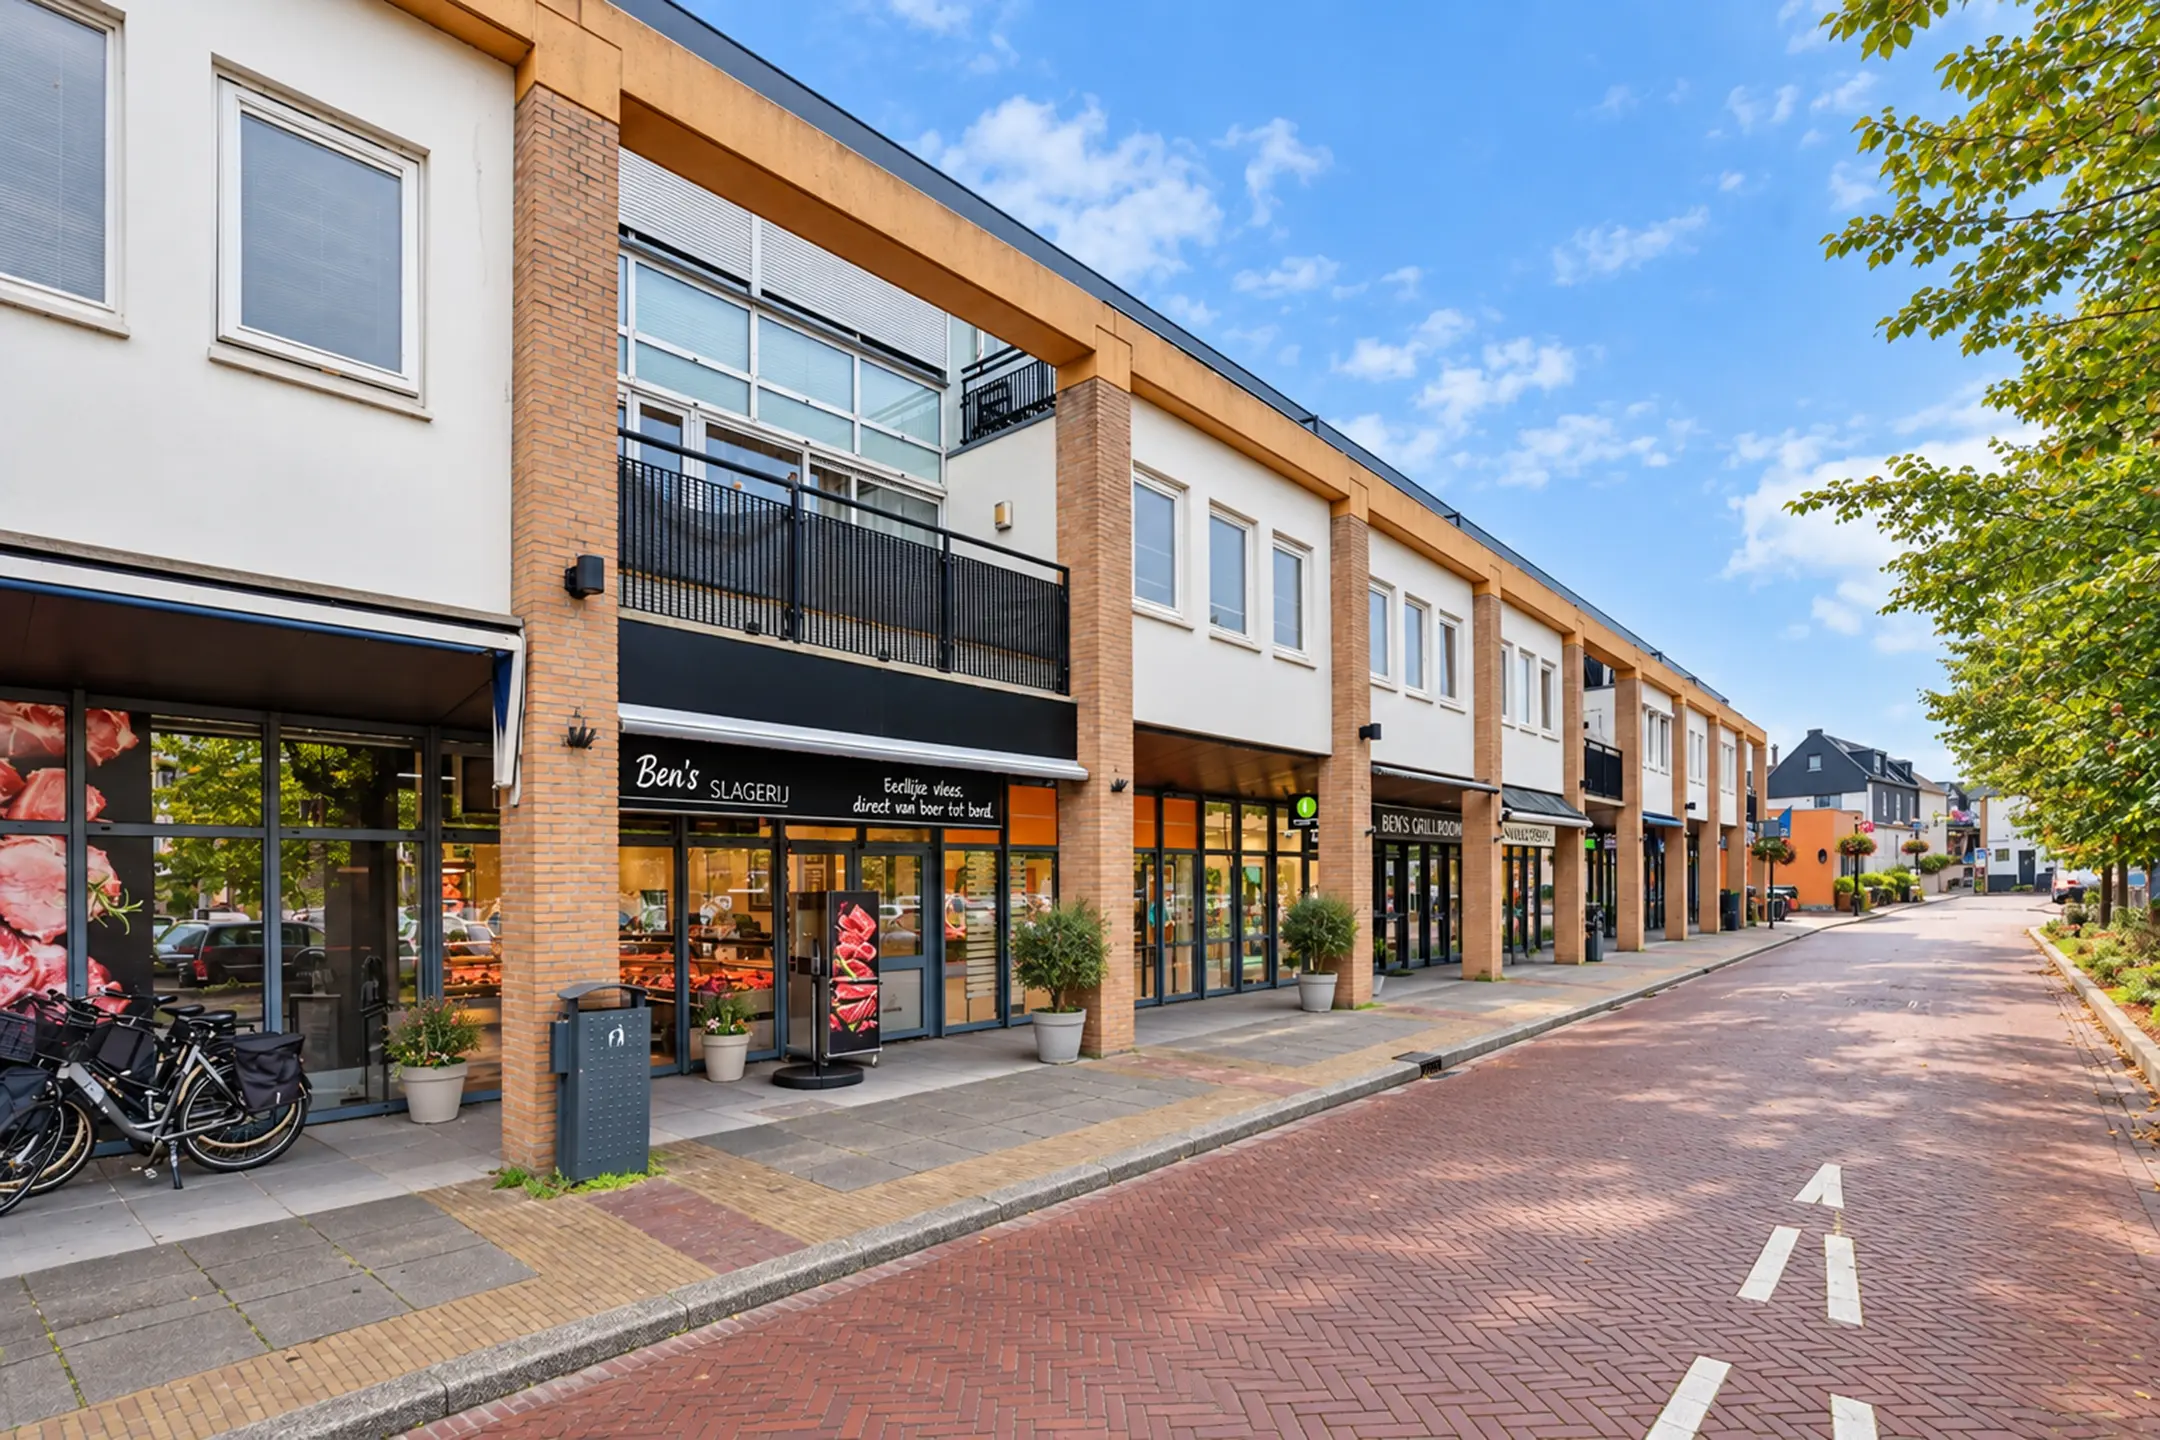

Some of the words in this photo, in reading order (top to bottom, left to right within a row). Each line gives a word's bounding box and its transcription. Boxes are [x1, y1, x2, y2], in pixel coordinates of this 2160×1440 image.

[636, 754, 699, 790] Ben's
[710, 779, 789, 803] SLAGERIJ
[853, 795, 891, 814] direct
[895, 802, 915, 815] van
[920, 799, 944, 816] boer
[948, 801, 965, 817] tot
